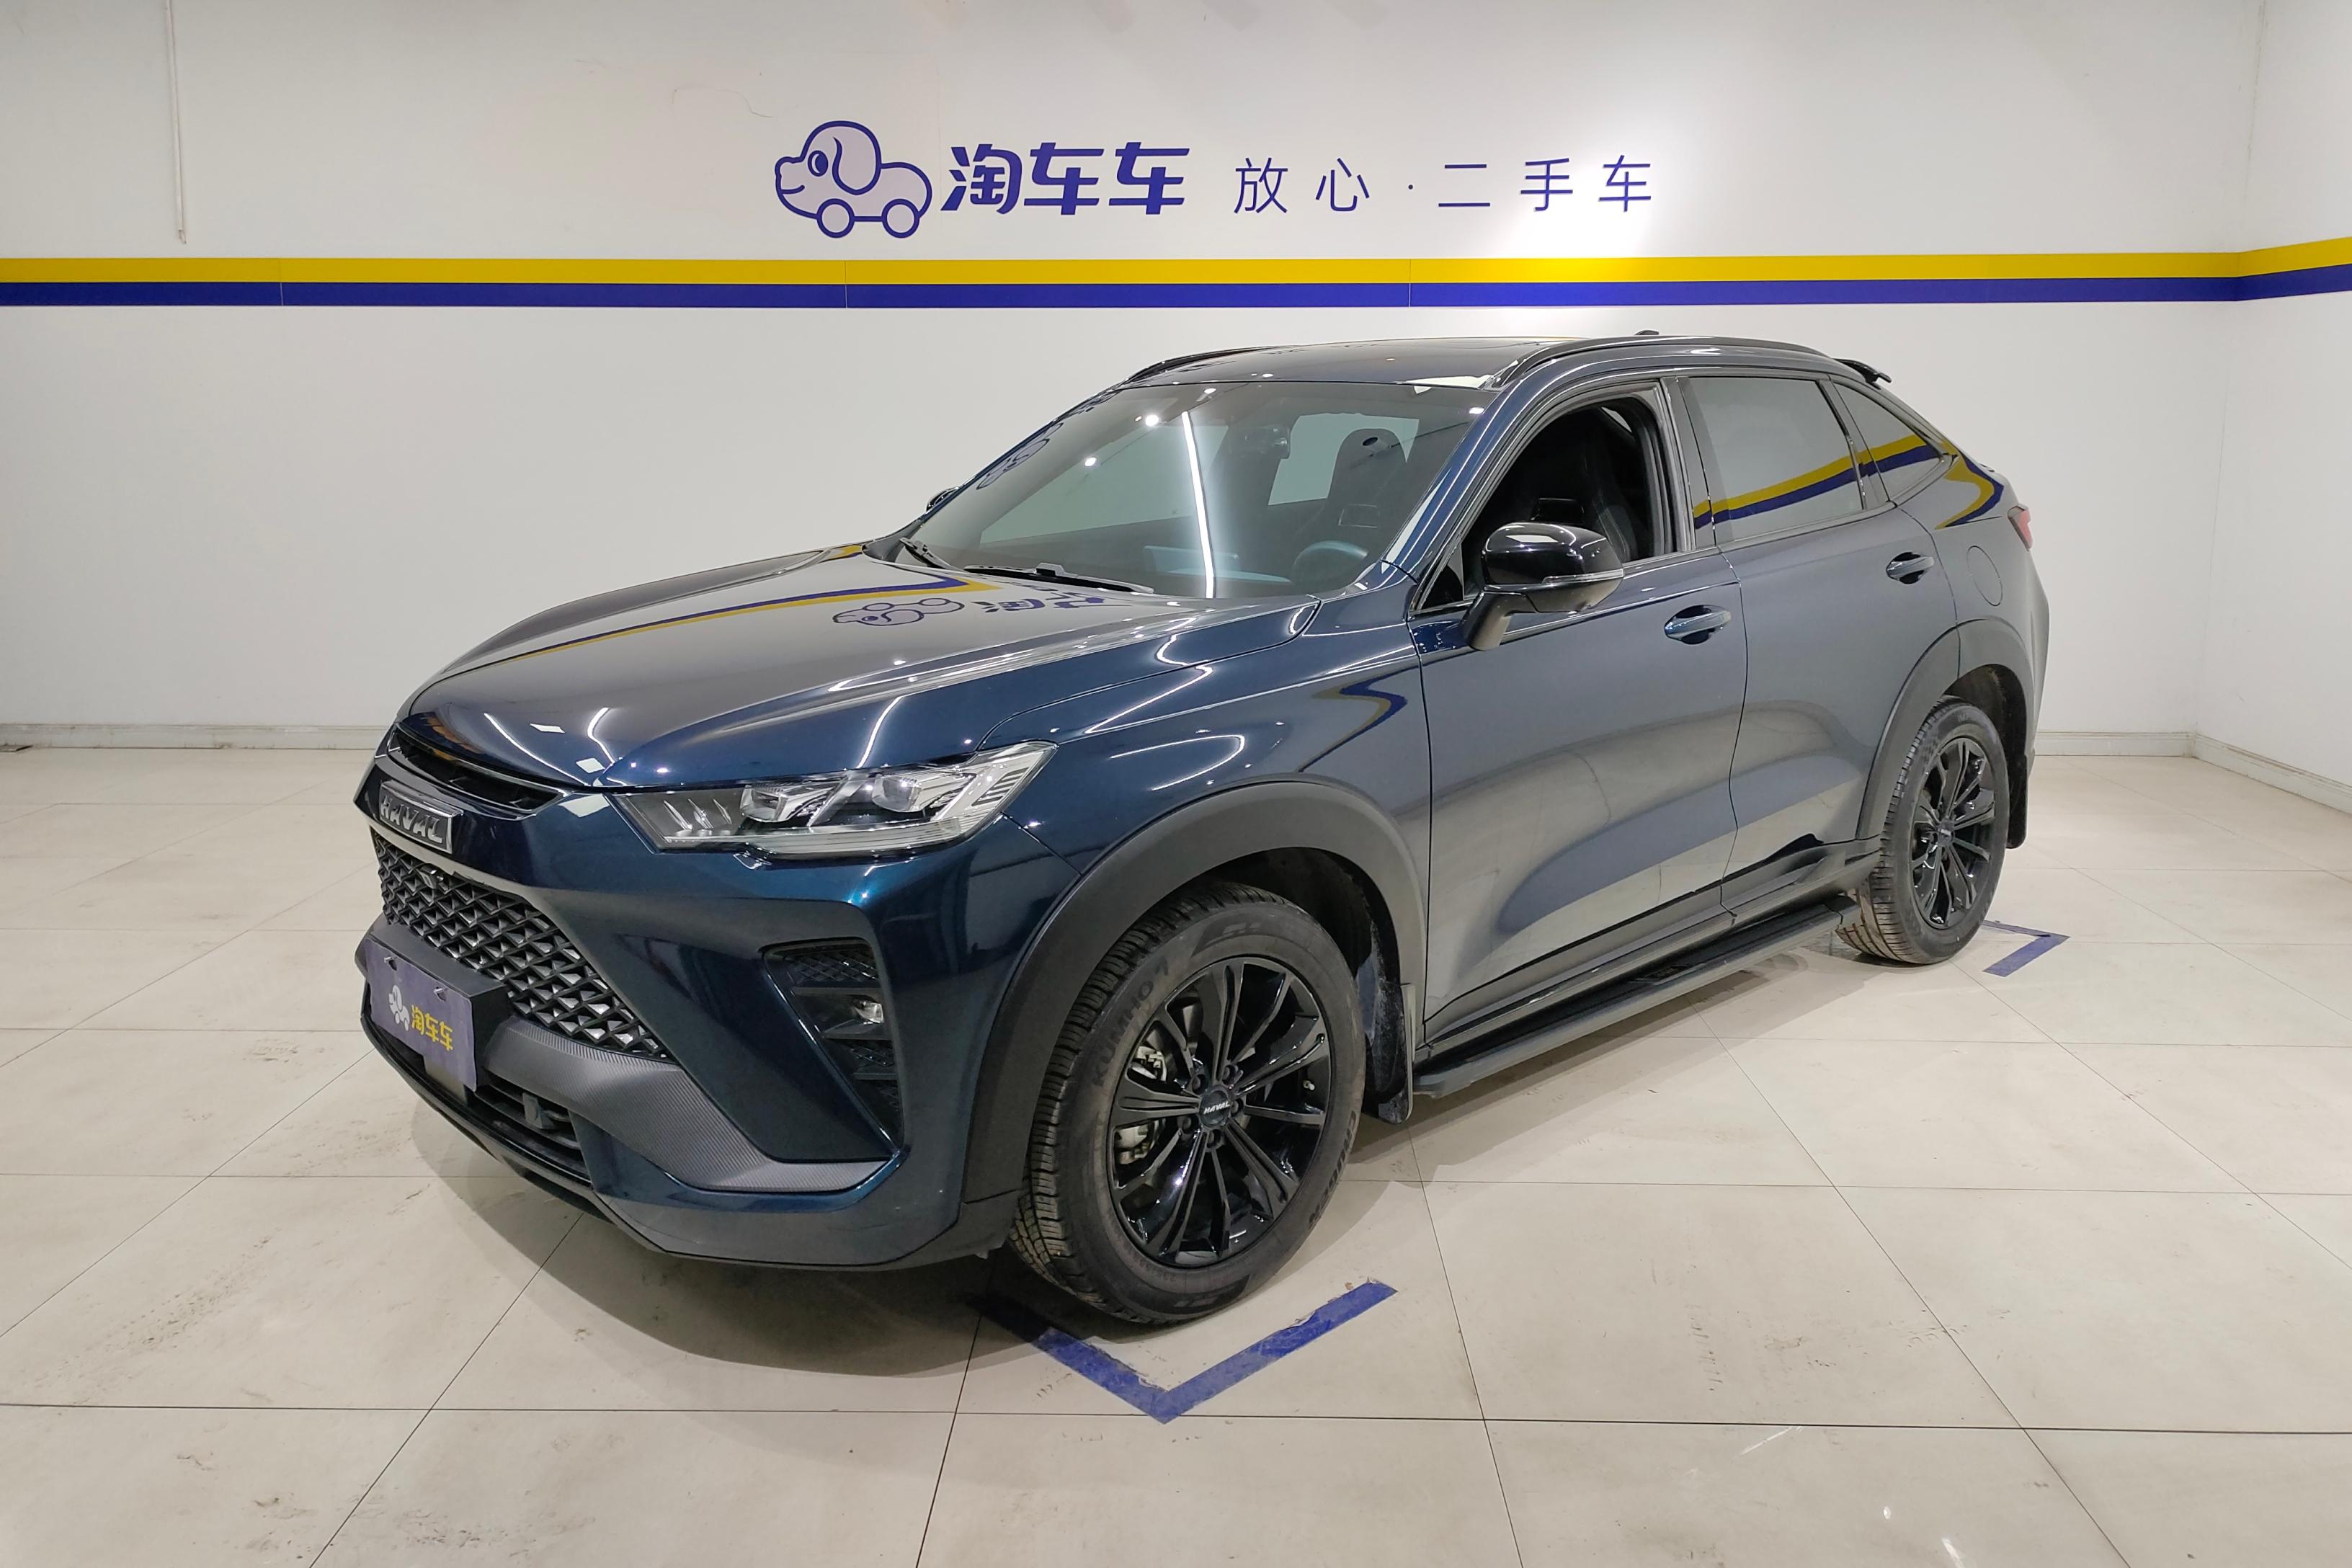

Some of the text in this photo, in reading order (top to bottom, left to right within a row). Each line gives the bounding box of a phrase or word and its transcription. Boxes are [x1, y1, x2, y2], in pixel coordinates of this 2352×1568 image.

[940, 142, 1190, 215] 淘车车
[380, 796, 443, 844] HAVAL
[411, 1006, 453, 1050] 淘车车
[1203, 1100, 1231, 1115] HAVAL
